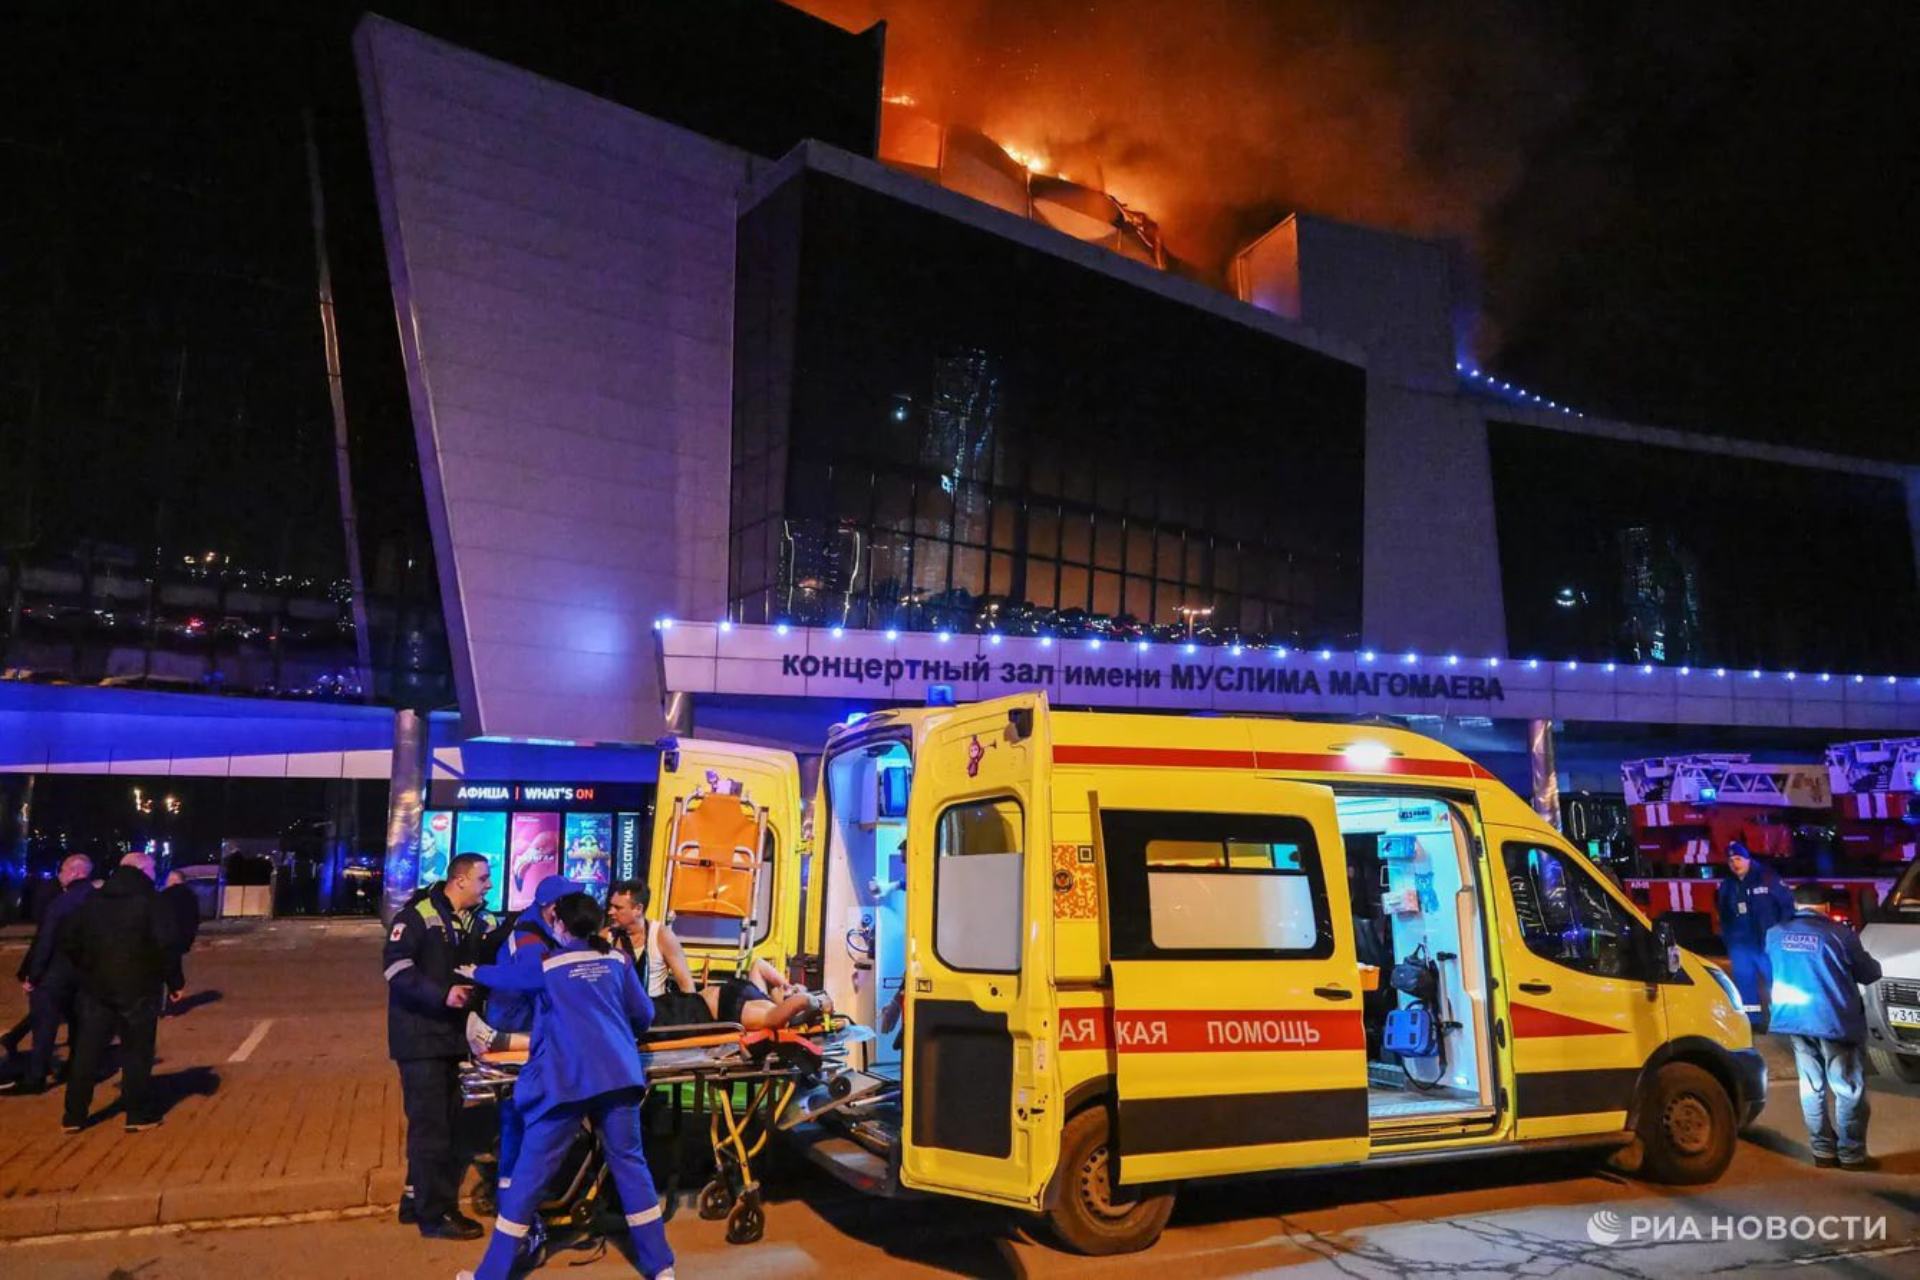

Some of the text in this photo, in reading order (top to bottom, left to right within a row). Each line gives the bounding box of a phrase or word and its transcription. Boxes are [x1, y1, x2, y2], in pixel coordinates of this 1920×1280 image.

[783, 654, 1504, 701] концертный зал имени МУСЛИМА МАГОМАЕВА
[458, 786, 509, 799] АФИША
[524, 787, 593, 799] WHAT'S ON
[623, 818, 634, 841] HALL
[623, 842, 634, 861] CITY
[1116, 1021, 1168, 1045] КАЯ
[1207, 1020, 1320, 1047] ПОМОЩЬ
